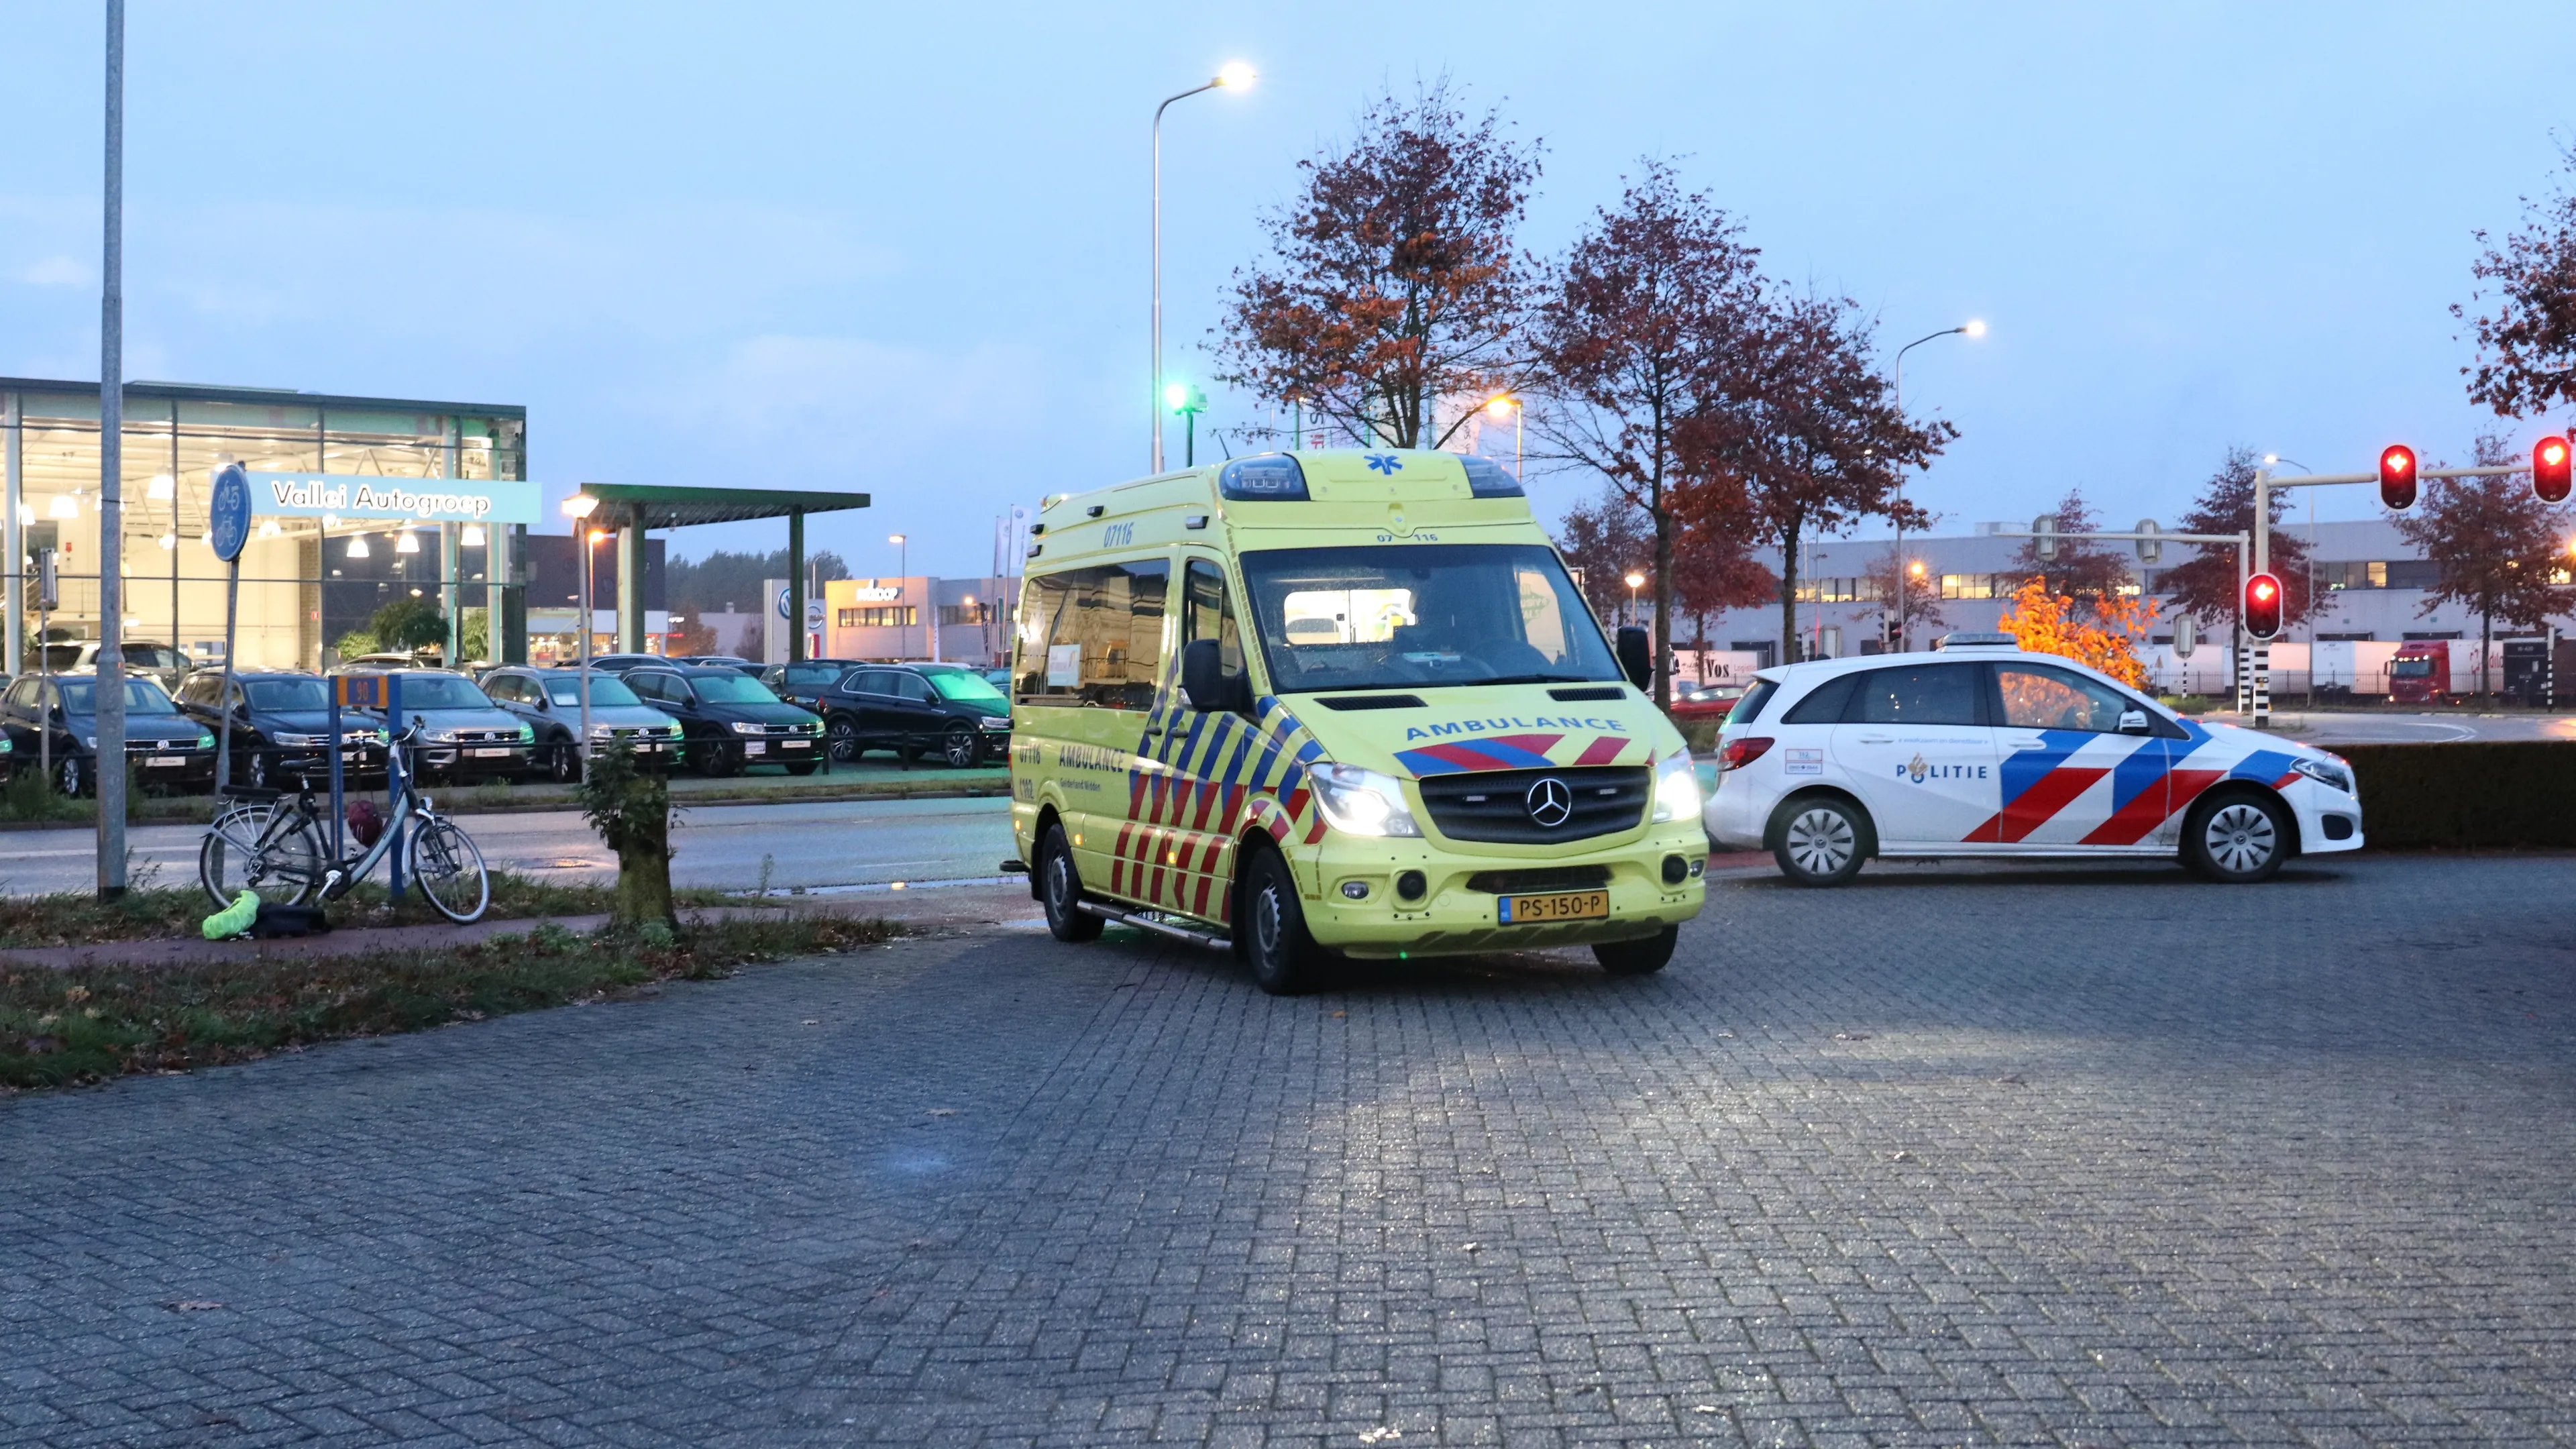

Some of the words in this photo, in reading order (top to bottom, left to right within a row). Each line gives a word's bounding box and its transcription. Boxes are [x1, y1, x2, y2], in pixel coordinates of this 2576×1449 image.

[272, 482, 345, 506] Vallei
[354, 486, 490, 517] Autogroep
[1104, 521, 1134, 548] 07116
[1377, 534, 1393, 542] 07
[1413, 533, 1438, 541] 116
[1705, 659, 1730, 678] Vos
[356, 680, 369, 702] 90
[1407, 716, 1627, 741] AMBULANCE
[1019, 743, 1040, 765] 07116
[1059, 745, 1125, 772] AMBULANCE
[1896, 764, 1988, 784] POLITIE
[1519, 895, 1600, 917] PS-150-P
